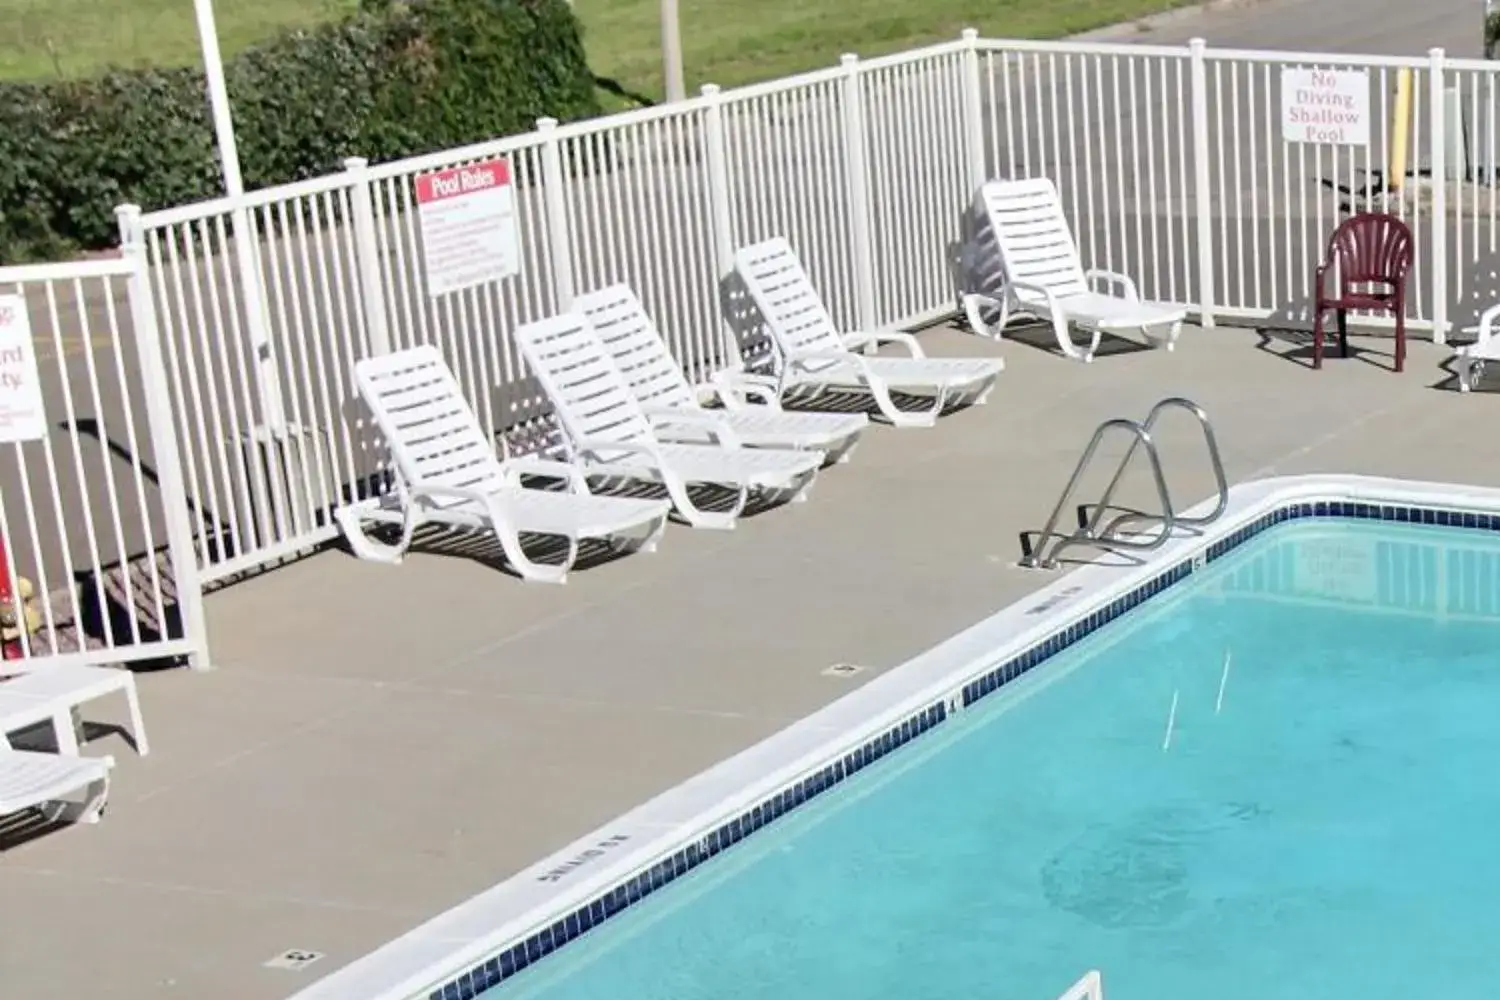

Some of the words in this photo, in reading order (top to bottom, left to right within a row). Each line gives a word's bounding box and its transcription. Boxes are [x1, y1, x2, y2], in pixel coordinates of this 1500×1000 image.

[1311, 71, 1337, 88] No
[1296, 89, 1356, 109] Diving
[1289, 107, 1360, 124] Shallow
[1306, 126, 1345, 142] Pool
[431, 172, 461, 198] Pool
[462, 167, 495, 190] Rules
